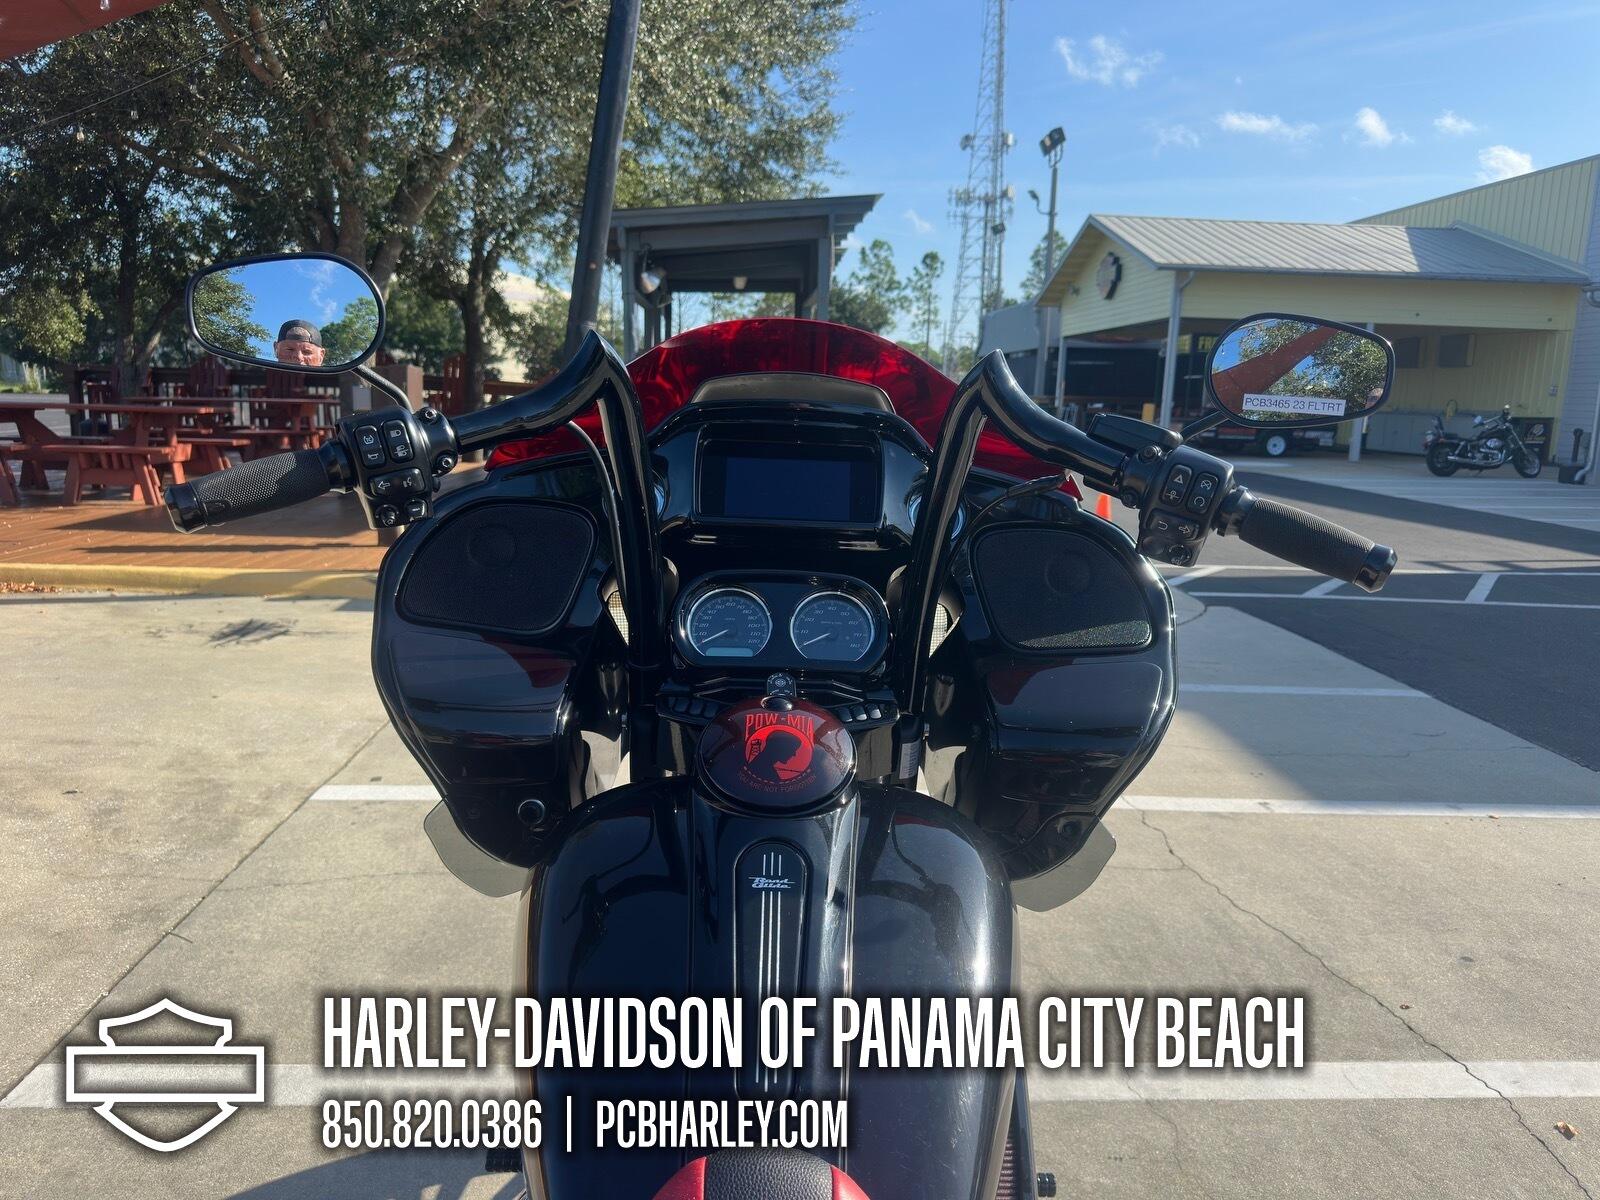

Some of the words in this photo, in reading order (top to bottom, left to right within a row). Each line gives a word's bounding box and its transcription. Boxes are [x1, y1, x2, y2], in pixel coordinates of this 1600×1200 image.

[1244, 397, 1291, 409] PCB3465
[1292, 400, 1306, 410] 23
[1307, 401, 1343, 412] FLTRT
